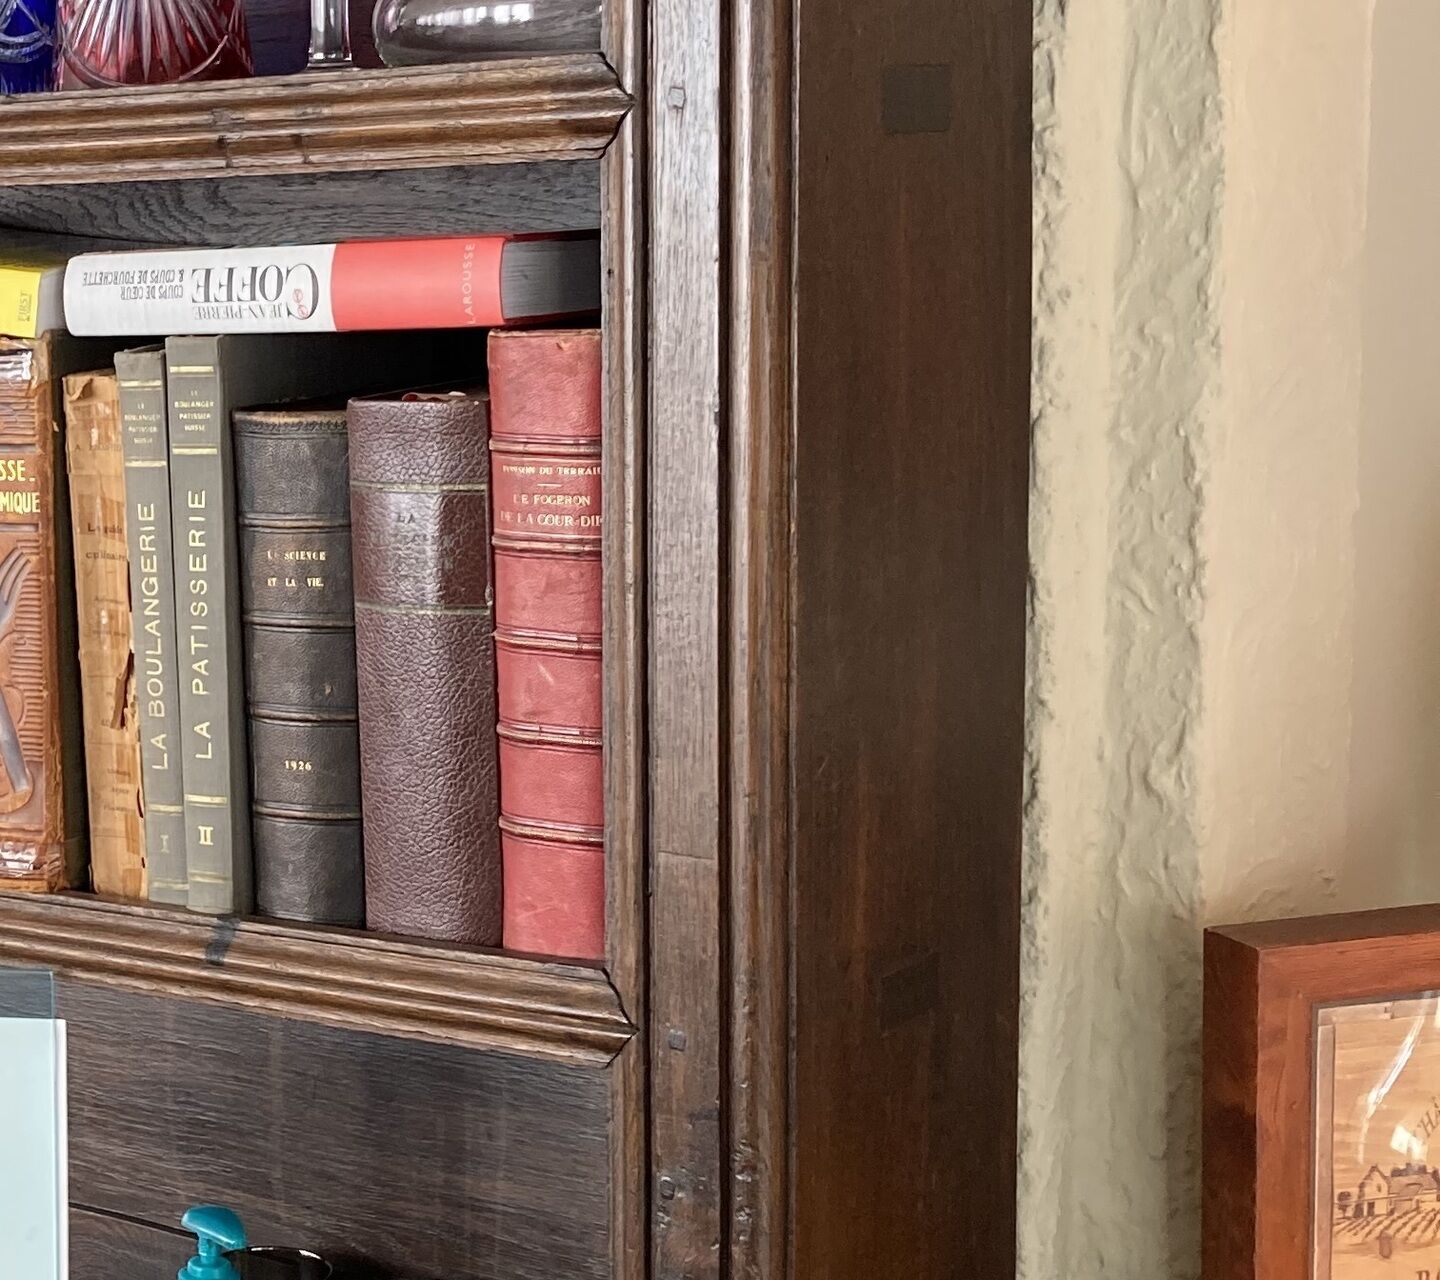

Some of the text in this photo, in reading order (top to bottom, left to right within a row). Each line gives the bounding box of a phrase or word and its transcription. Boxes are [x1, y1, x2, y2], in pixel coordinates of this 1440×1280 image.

[82, 270, 136, 286] FOURCHETTE
[137, 270, 148, 284] DE
[150, 269, 176, 284] COUPS
[466, 242, 476, 326] LAROUSSE
[145, 286, 157, 299] DE
[158, 285, 184, 299] COUPS
[192, 263, 320, 320] COFFE
[193, 303, 283, 320] JEAN-PIERRE
[539, 466, 553, 475] DU
[513, 494, 529, 504] LE
[517, 513, 533, 524] LA
[284, 551, 327, 561] SCIENCE
[285, 578, 296, 587] LA
[188, 489, 213, 760] LA PATISSERIE
[137, 503, 169, 770] LA BOULANGERIE
[284, 760, 312, 771] 1926
